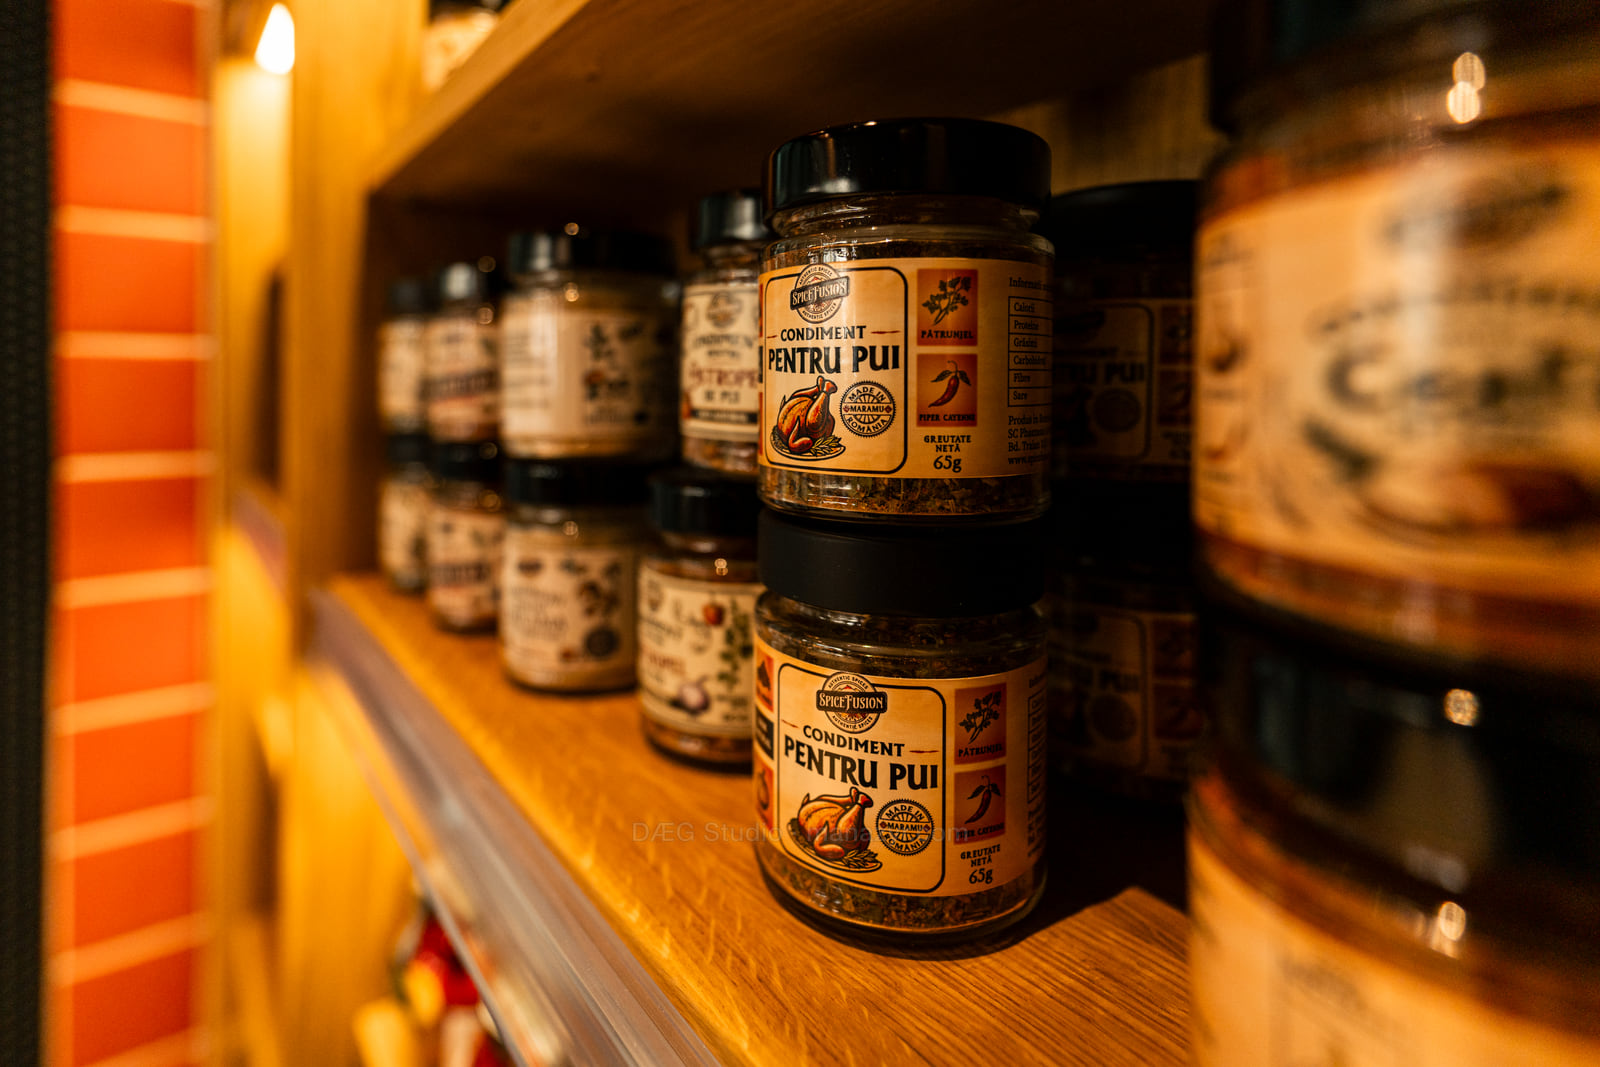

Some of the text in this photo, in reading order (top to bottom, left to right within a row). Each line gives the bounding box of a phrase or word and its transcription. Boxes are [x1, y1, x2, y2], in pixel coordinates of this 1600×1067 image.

[780, 324, 867, 342] CONDIMENT
[769, 345, 900, 374] PENTRU PUI
[848, 387, 887, 401] MADE IN
[850, 405, 884, 413] MARAMU
[919, 414, 940, 422] PIPER
[924, 435, 972, 443] GREUTATE
[933, 455, 962, 473] 65g
[802, 724, 905, 757] CONDIMENT
[784, 733, 938, 791] PENTRU PUI
[885, 804, 925, 820] MADE IN
[887, 822, 922, 832] MARAMU
[960, 843, 1001, 860] GREUTATE
[968, 867, 993, 884] 65g
